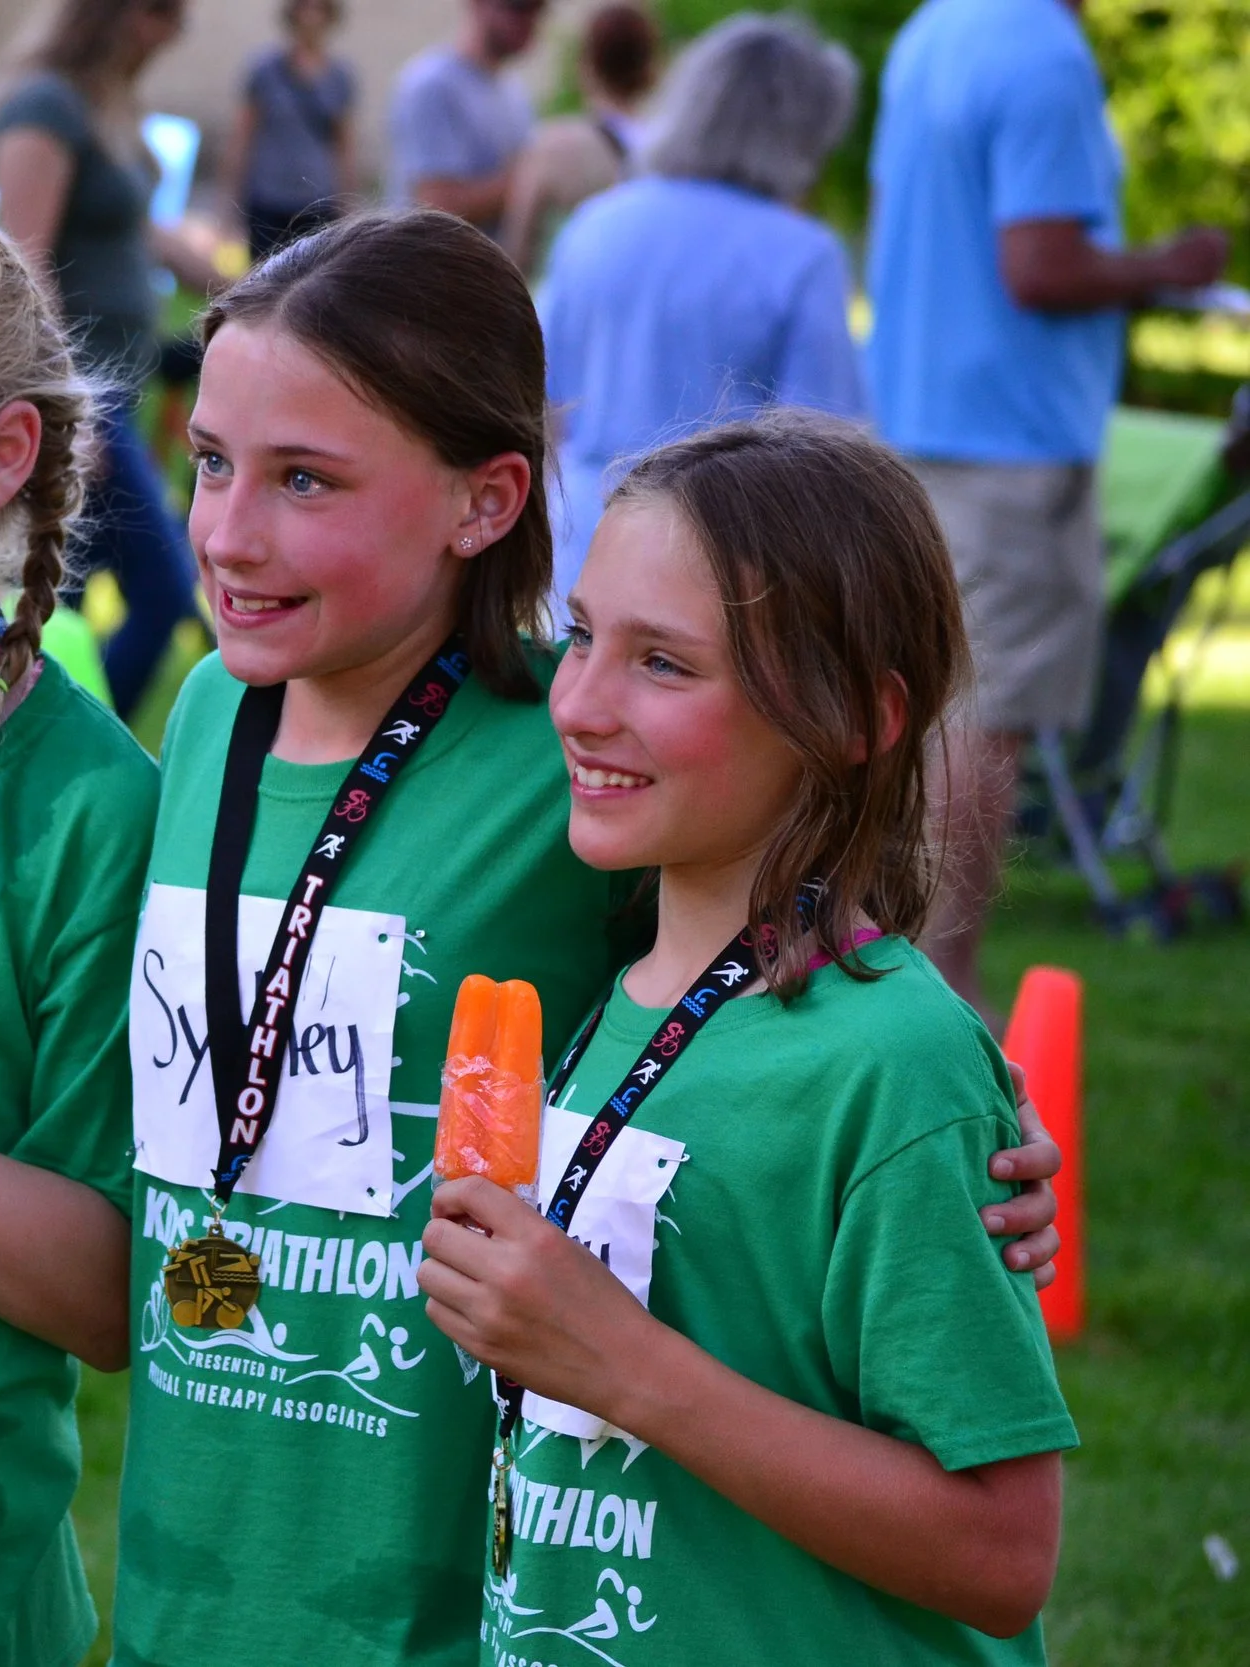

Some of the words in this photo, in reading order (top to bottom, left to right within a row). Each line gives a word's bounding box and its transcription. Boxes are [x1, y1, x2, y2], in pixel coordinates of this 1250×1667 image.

[143, 948, 369, 1147] Syey
[229, 874, 324, 1144] TRIATHLON
[186, 1379, 267, 1412] THERAPY
[271, 1397, 388, 1438] ASSOCIATES
[188, 1350, 265, 1378] PRESENTED
[270, 1365, 287, 1383] BY
